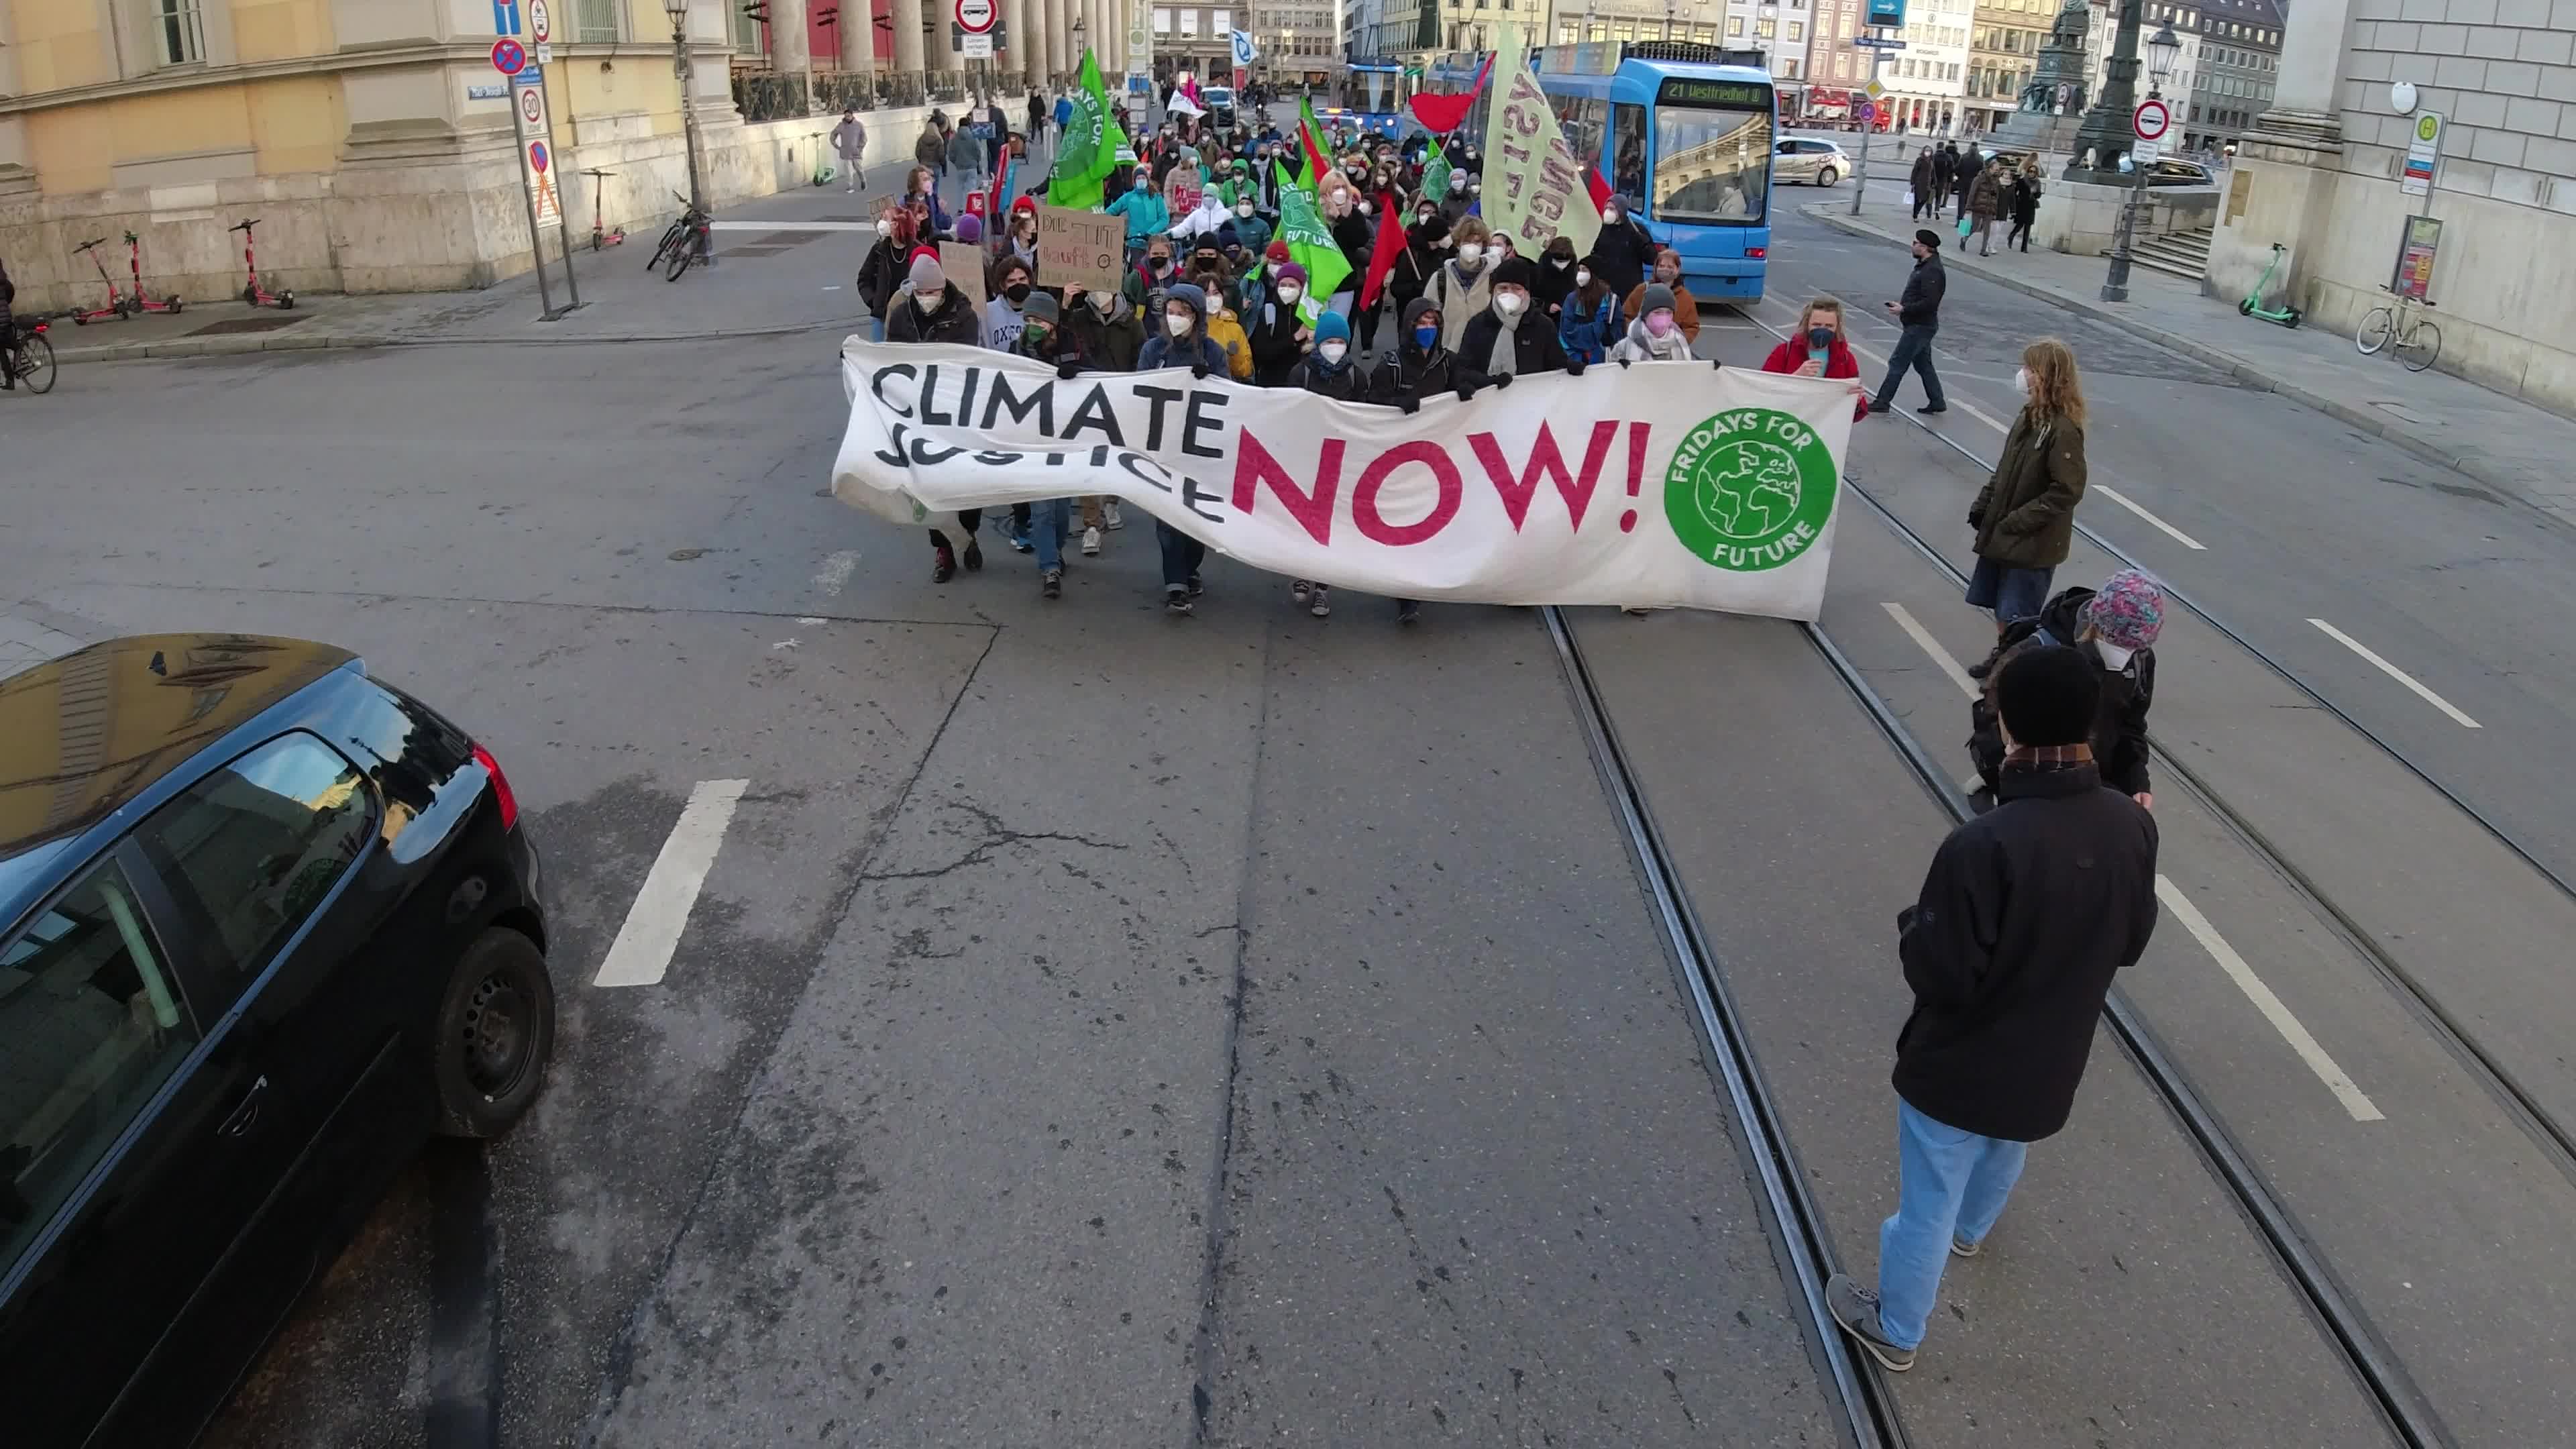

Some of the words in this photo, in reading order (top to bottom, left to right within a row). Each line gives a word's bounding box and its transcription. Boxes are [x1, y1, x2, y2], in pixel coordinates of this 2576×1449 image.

[526, 97, 537, 113] 30
[1669, 83, 1684, 97] 21
[1689, 83, 1750, 101] Westfriedhof
[1091, 114, 1103, 146] FOR
[1042, 215, 1067, 233] DIE
[872, 363, 1229, 459] CLIMATE
[1672, 412, 1758, 483] FRIDAYS
[1766, 415, 1815, 453] FOR
[874, 422, 1226, 524] JUCE
[1231, 417, 1652, 547] NOW!
[1713, 519, 1817, 567] FUTURE
